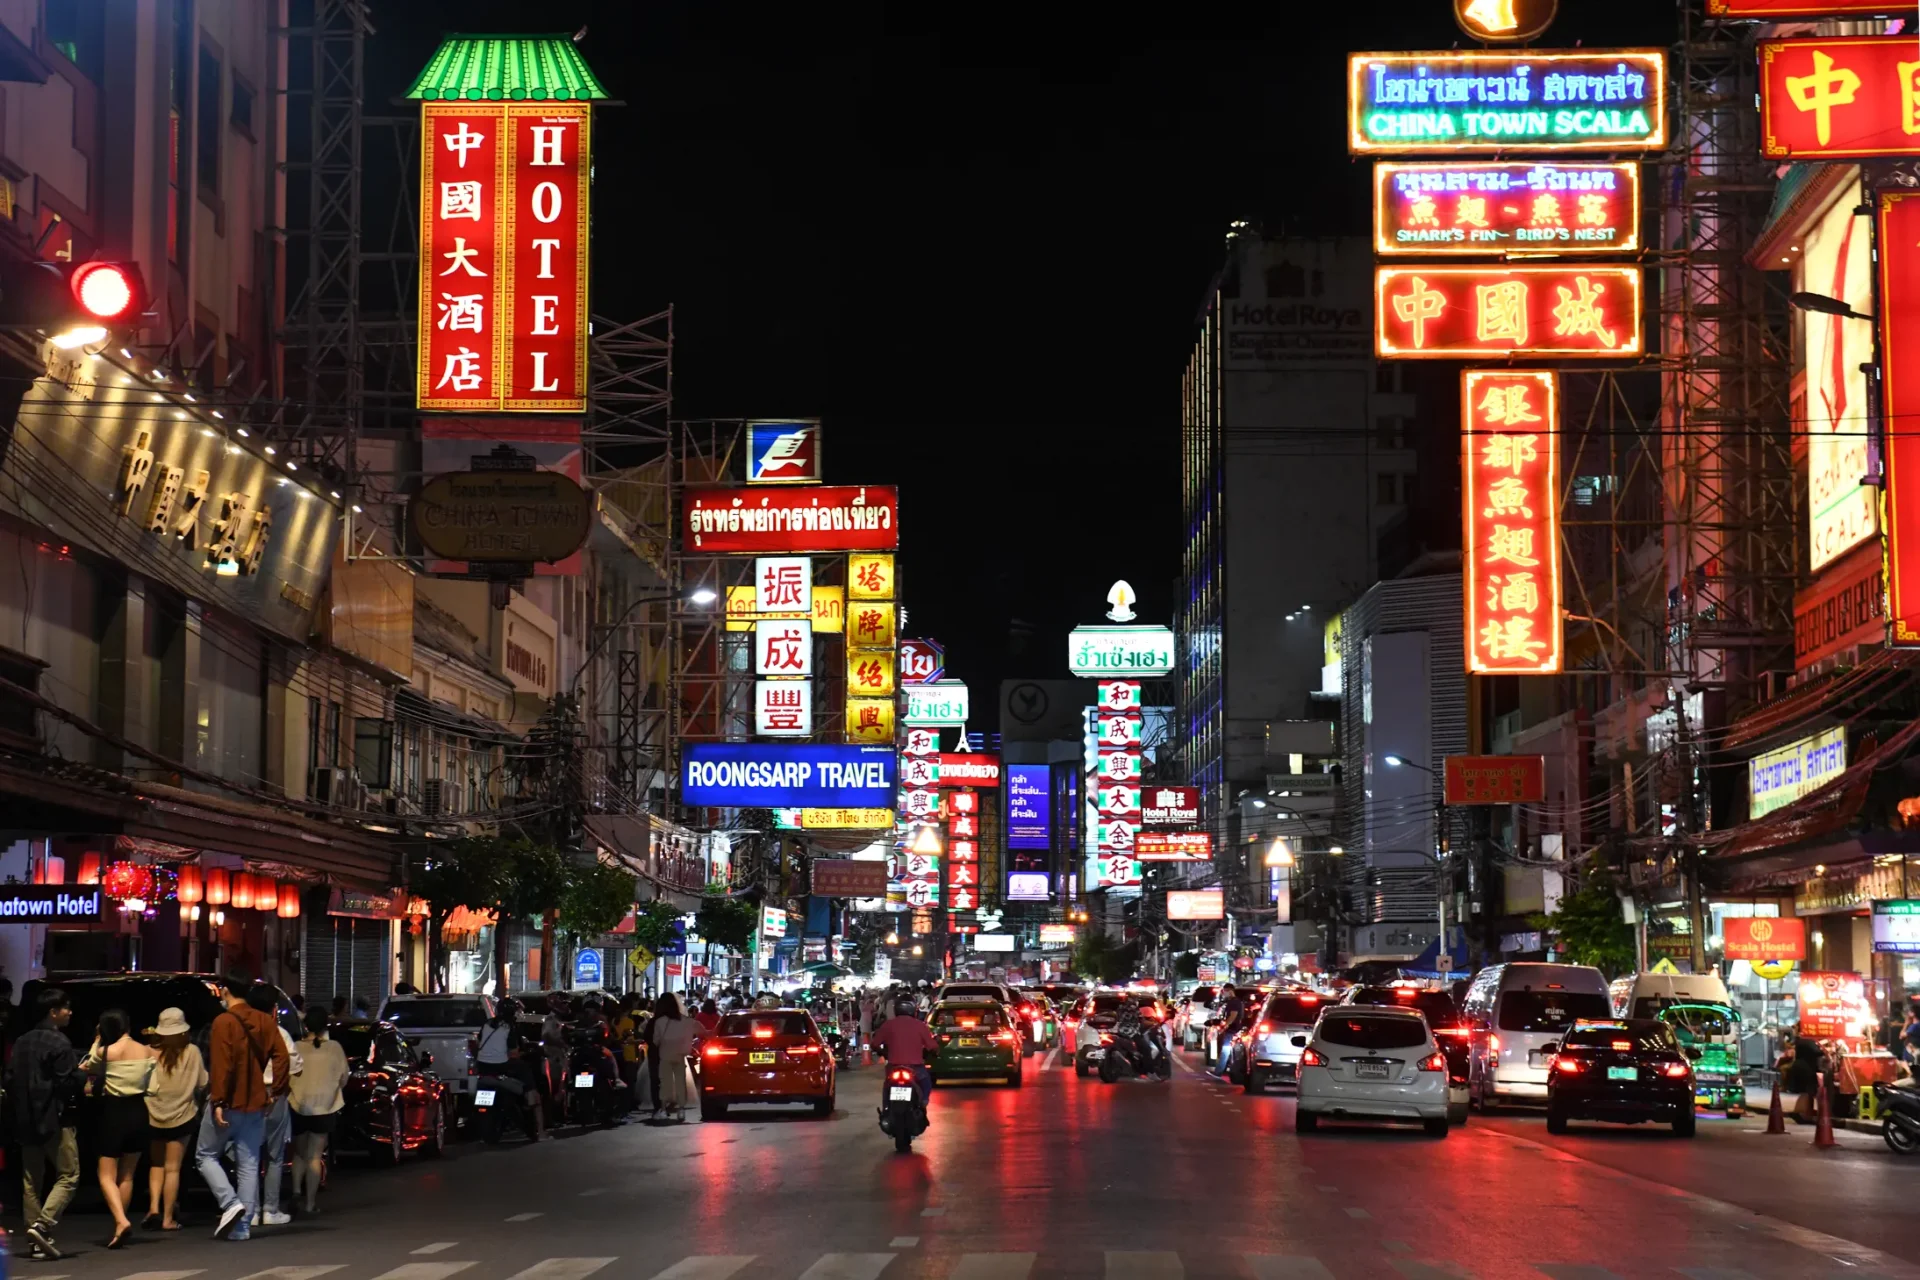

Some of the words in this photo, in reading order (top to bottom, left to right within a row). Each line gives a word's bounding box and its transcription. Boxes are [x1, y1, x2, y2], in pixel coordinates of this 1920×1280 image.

[1369, 112, 1455, 136] CHINA
[1463, 111, 1548, 135] TOWN
[1555, 110, 1649, 135] SCALA
[1396, 228, 1465, 242] SHARK'S
[1516, 227, 1570, 241] BIRD'S
[1574, 227, 1616, 241] NEST
[436, 123, 488, 392] 中國大酒店
[530, 126, 566, 392] HOTEL
[1393, 276, 1616, 349] 中國城
[425, 504, 502, 529] CHINA
[511, 504, 580, 529] TOWN
[690, 488, 890, 546] รุ่งทรัพย์การท่องเที่ยว
[1477, 385, 1547, 662] 銀都魚翅酒樓
[464, 532, 538, 551] HOTEL
[763, 566, 804, 730] 振成豐
[688, 761, 812, 788] ROONGSARP
[817, 762, 891, 788] TRAVEL
[1143, 808, 1168, 817] Hotel
[1170, 808, 1198, 818] Royal
[0, 896, 53, 916] atown
[57, 892, 98, 915] Hotel
[1727, 942, 1759, 952] Scala
[1761, 942, 1796, 952] Hostel
